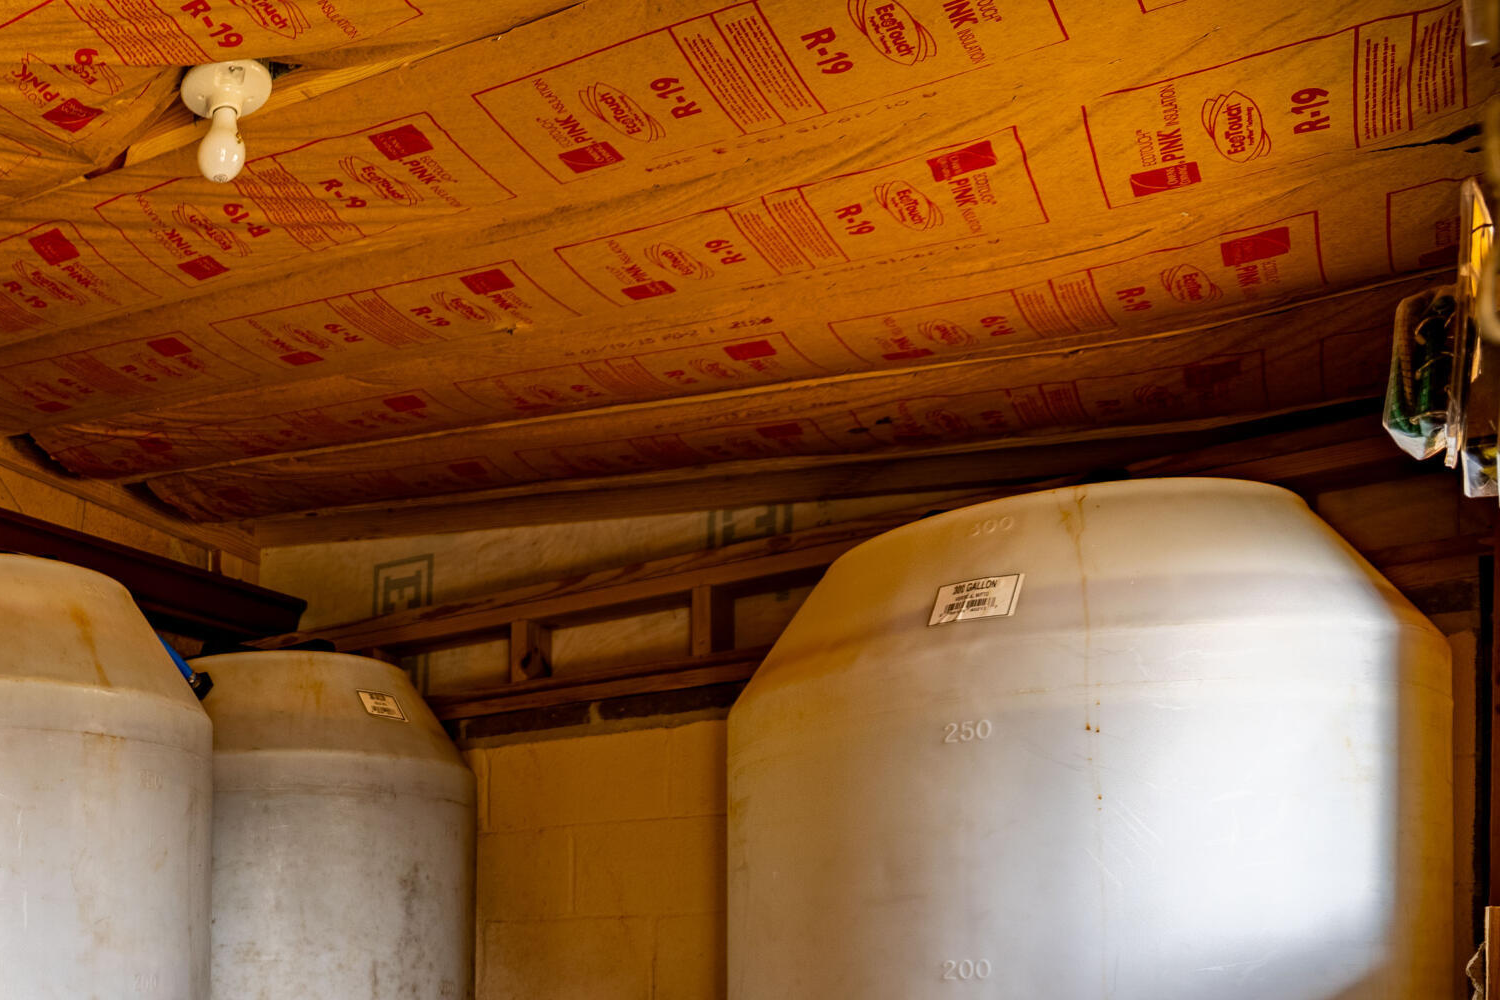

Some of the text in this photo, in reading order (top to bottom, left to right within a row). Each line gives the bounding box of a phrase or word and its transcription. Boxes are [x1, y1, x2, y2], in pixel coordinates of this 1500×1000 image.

[181, 0, 243, 48] R-19
[875, 3, 917, 57] EcoTouch
[943, 0, 979, 29] INK
[800, 26, 854, 74] R-19
[12, 63, 60, 102] PINK
[650, 77, 703, 119] R-19
[600, 92, 643, 136] EcoTouch
[1157, 84, 1185, 163] PINK INSULATION
[1291, 88, 1330, 134] R-19
[554, 114, 590, 145] PINK
[1224, 103, 1246, 155] EcoTouch
[403, 159, 440, 185] PINK
[948, 177, 979, 208] PINK
[223, 203, 271, 238] R-19
[834, 203, 875, 235] R-19
[165, 228, 198, 257] PINK
[705, 239, 747, 265] R-19
[61, 264, 93, 289] PINK
[966, 580, 998, 592] GALLON
[942, 718, 993, 745] 250
[942, 957, 993, 983] 200
